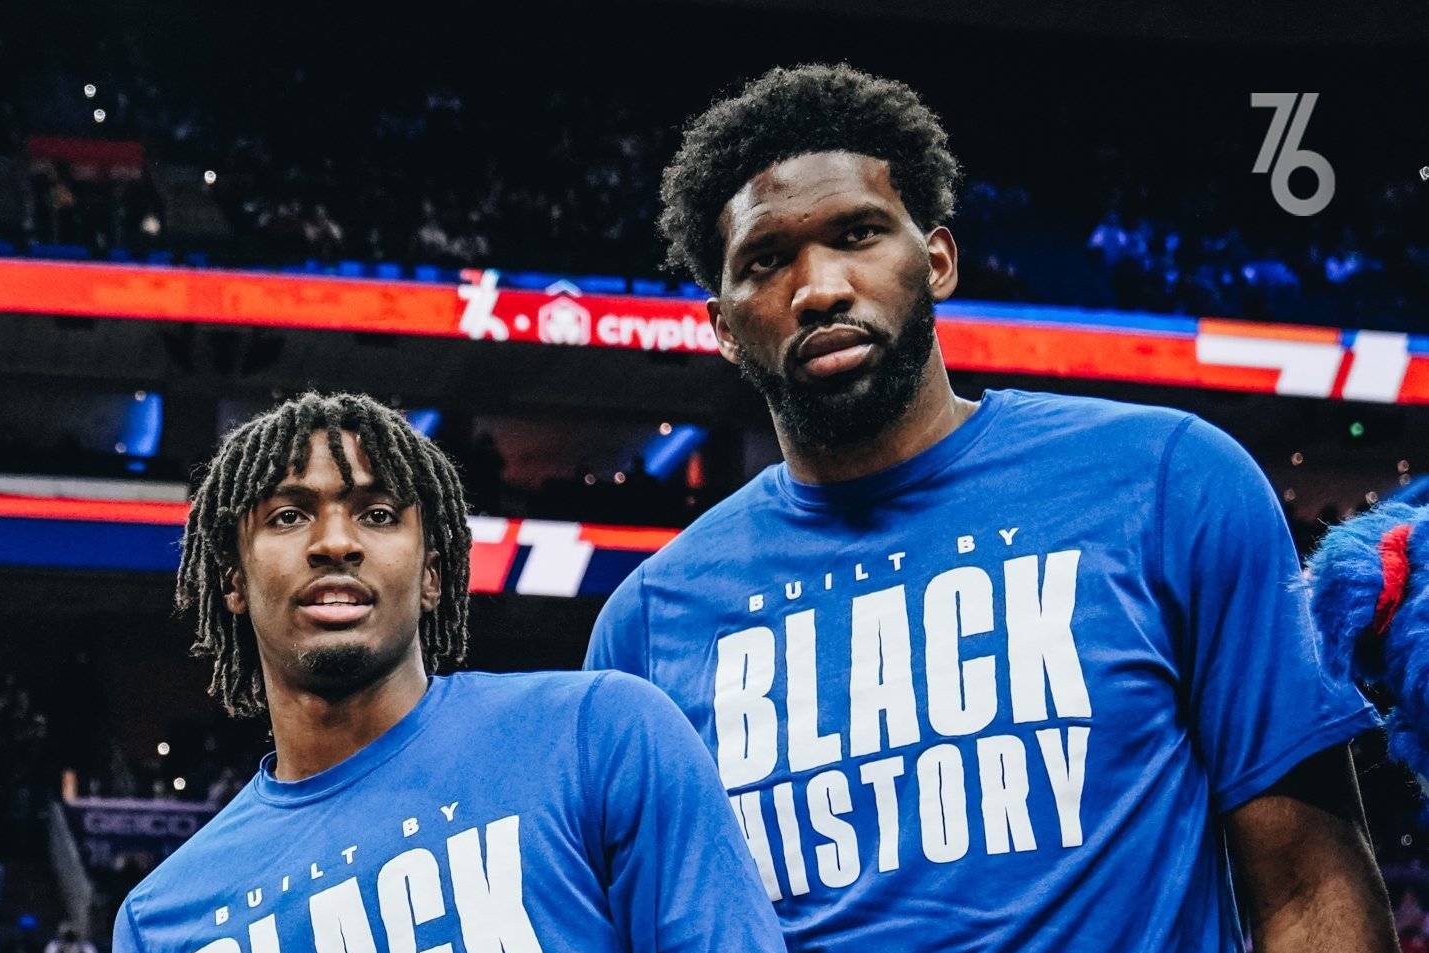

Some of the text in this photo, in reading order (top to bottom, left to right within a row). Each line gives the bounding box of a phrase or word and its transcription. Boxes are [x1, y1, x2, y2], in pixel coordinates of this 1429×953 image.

[748, 528, 1019, 612] BUILT BY
[714, 549, 1093, 791] BLACK
[215, 802, 459, 926] BUILT BY
